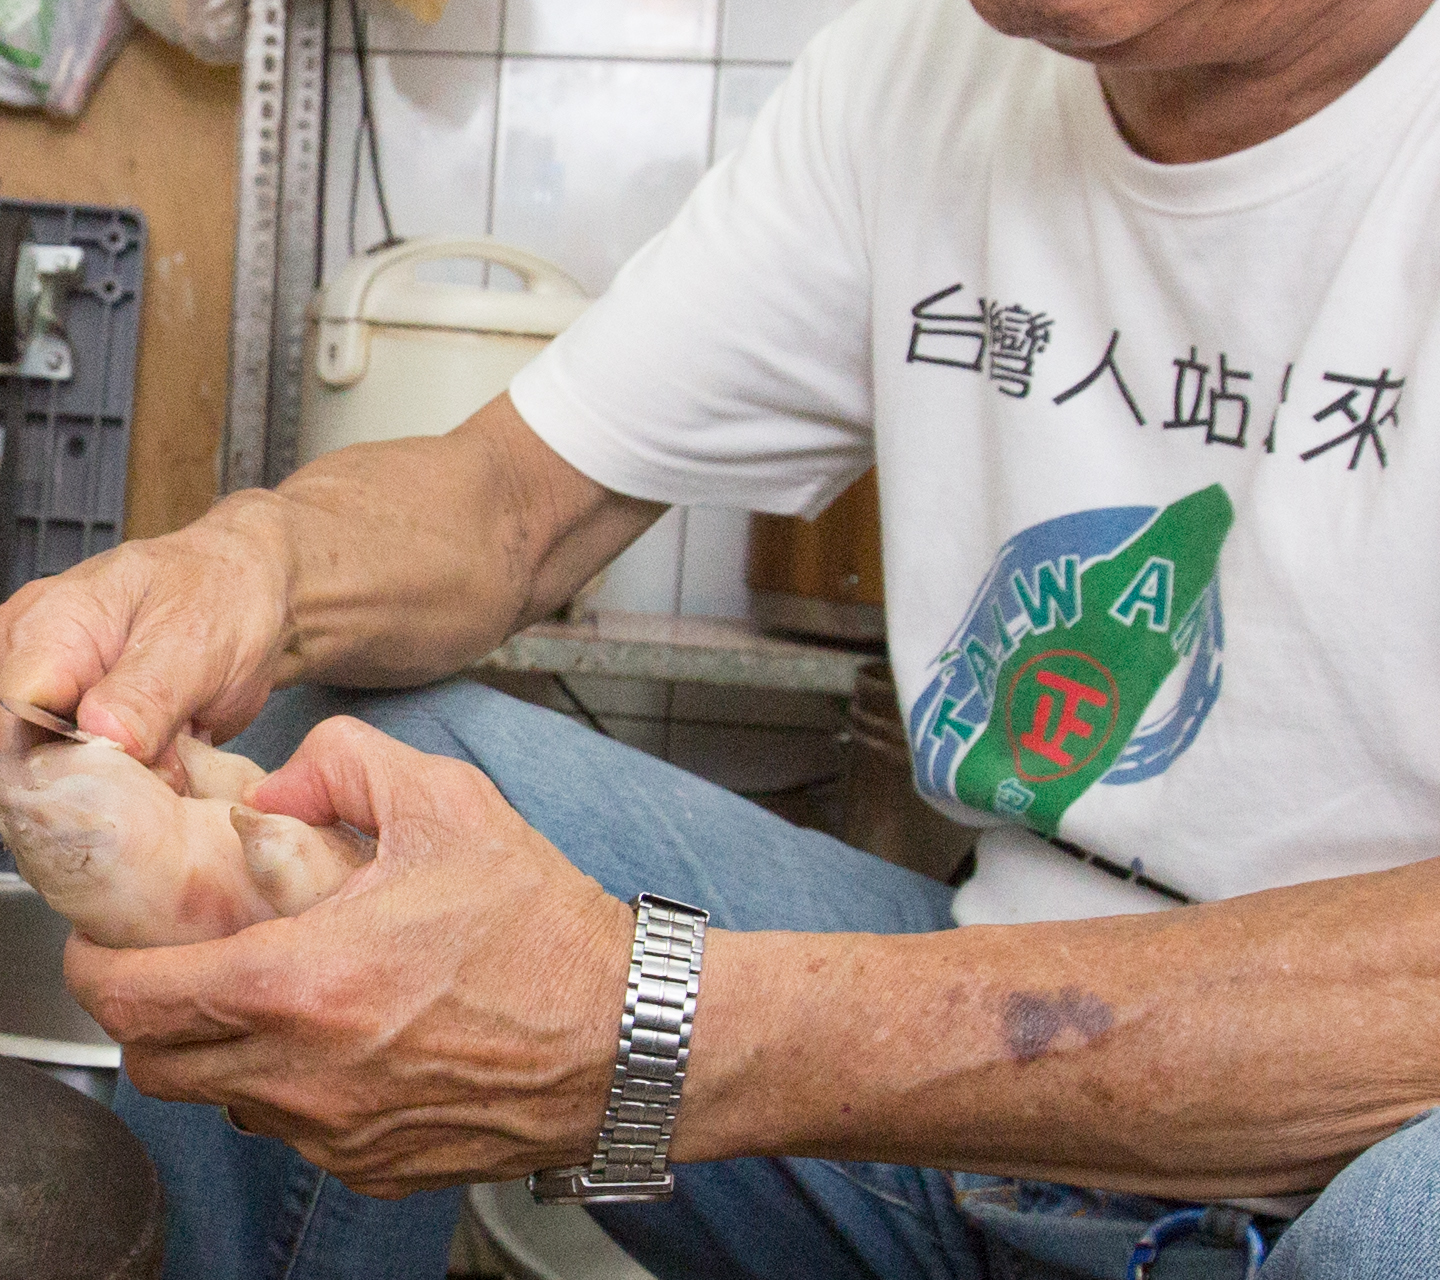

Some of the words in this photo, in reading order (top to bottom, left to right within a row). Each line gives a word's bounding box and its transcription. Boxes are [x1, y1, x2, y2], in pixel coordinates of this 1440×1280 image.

[906, 283, 1406, 472] 台灣人站來
[1020, 670, 1108, 766] 正
